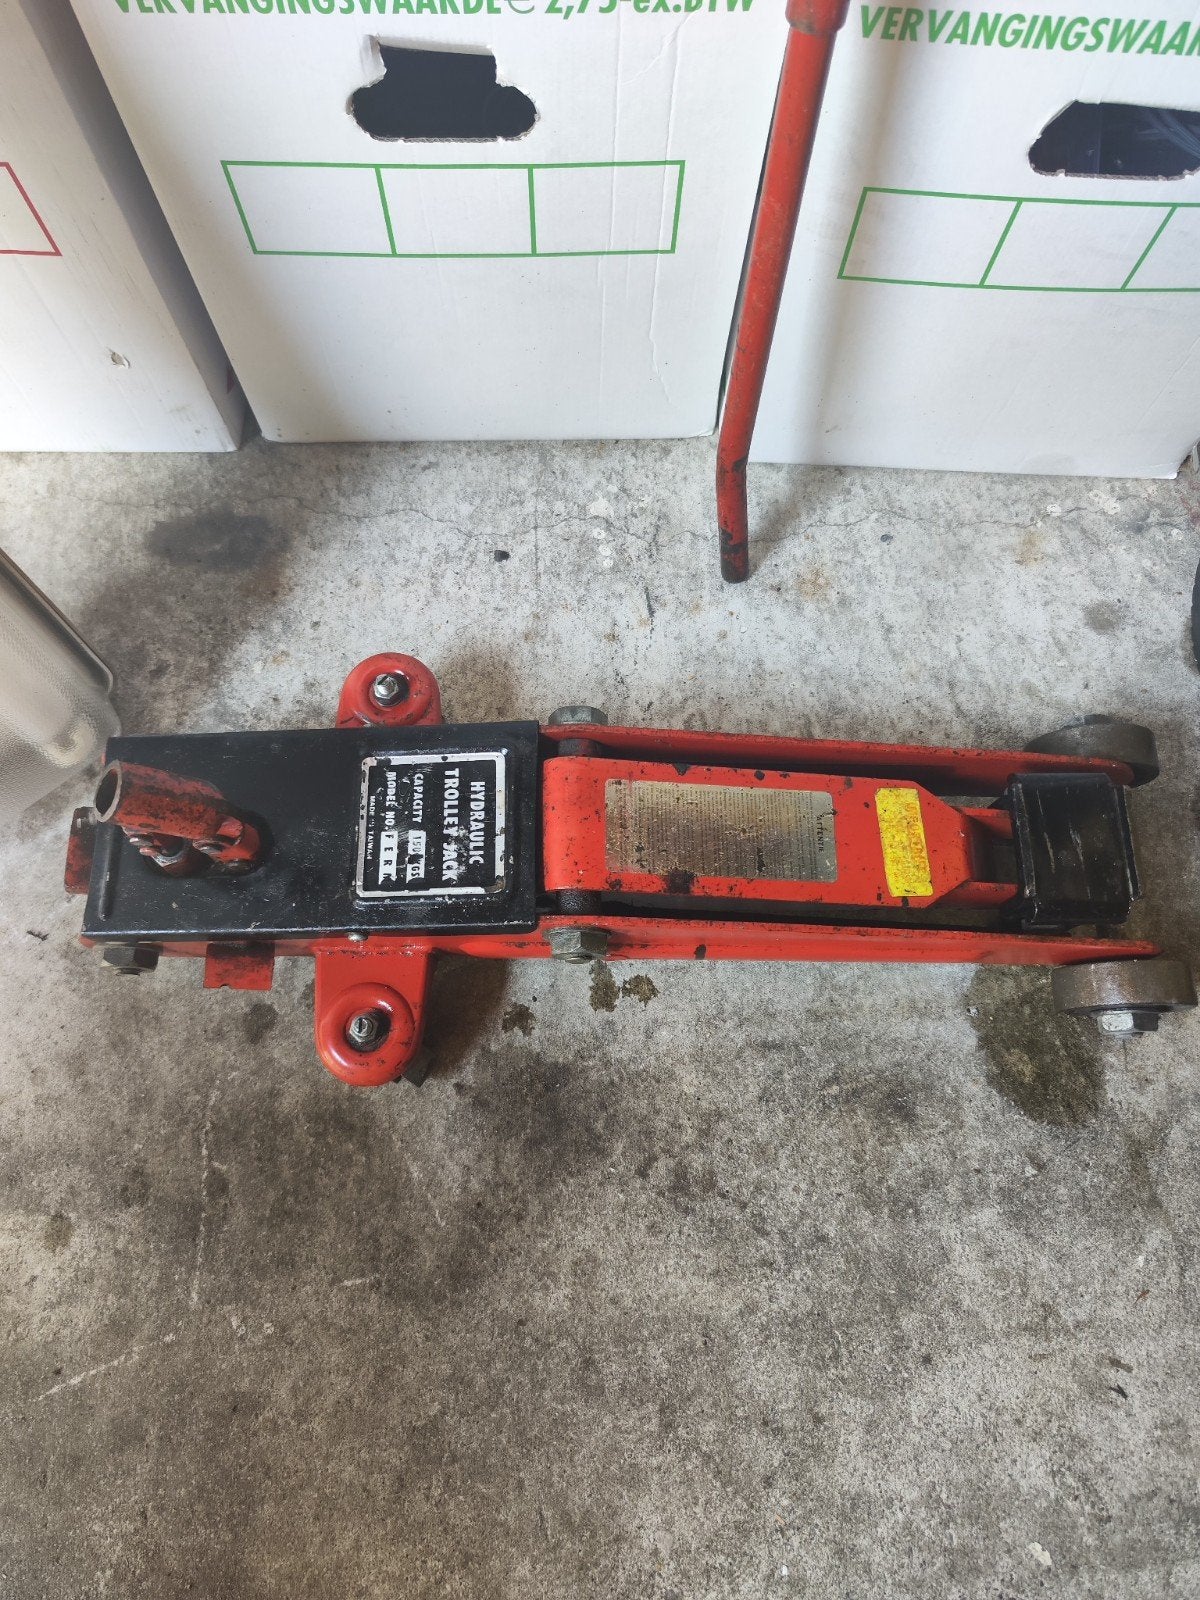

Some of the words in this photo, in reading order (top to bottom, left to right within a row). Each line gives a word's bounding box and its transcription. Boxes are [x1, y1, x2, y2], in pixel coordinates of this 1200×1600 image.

[860, 4, 1200, 57] VERVANGINGSWAA
[368, 795, 376, 816] MADE
[385, 771, 397, 807] MODEL
[412, 773, 424, 823] CAPACITY
[443, 768, 460, 837] TROLLEY
[468, 781, 486, 865] HYDRAULIC
[442, 843, 459, 881] JACK
